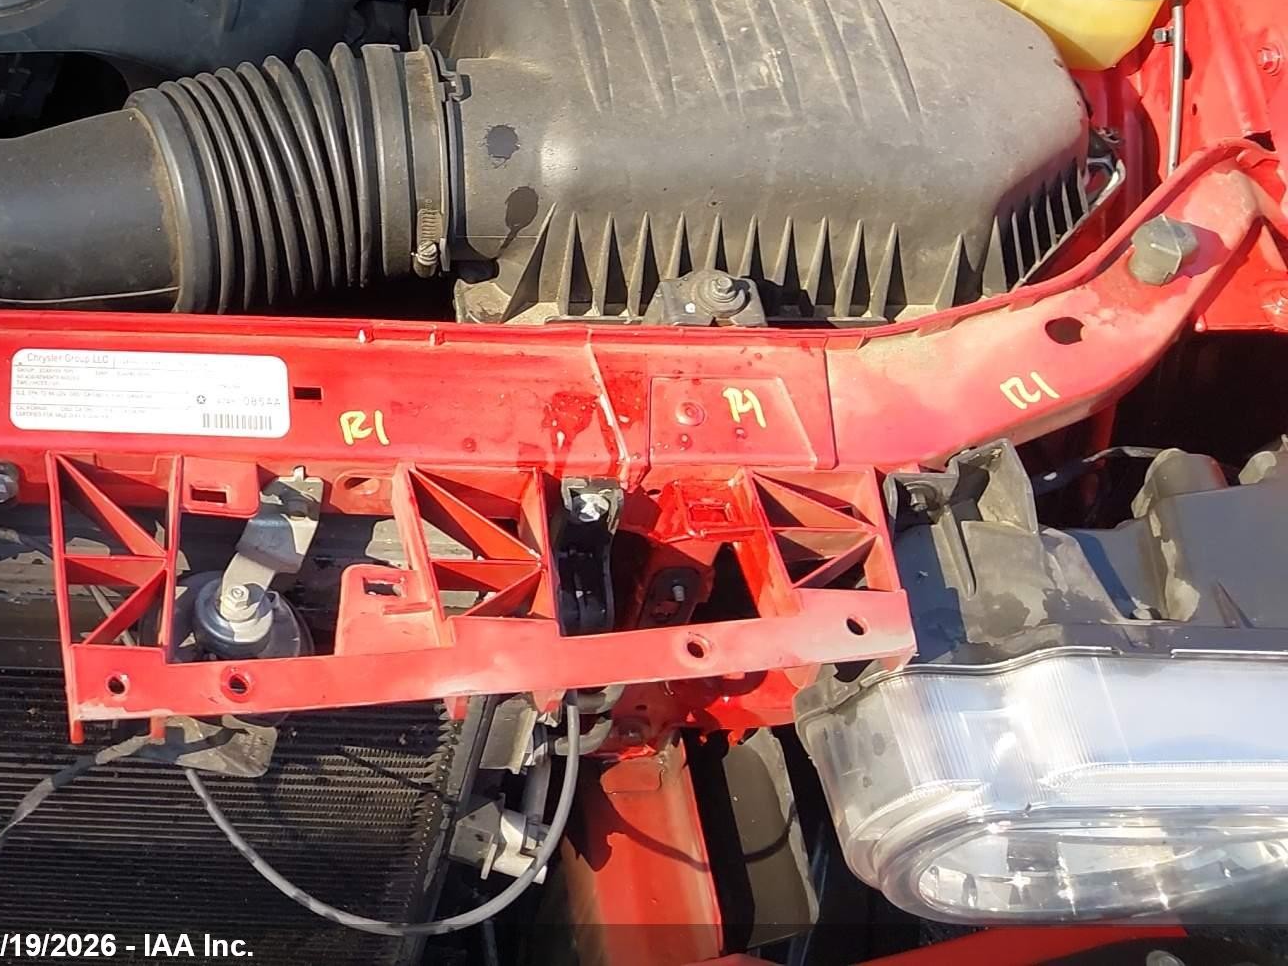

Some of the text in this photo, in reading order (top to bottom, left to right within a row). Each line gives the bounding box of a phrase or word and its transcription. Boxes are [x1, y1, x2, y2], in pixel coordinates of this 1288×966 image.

[26, 352, 62, 364] Chrysler
[64, 353, 90, 364] Group
[92, 354, 110, 364] LLC
